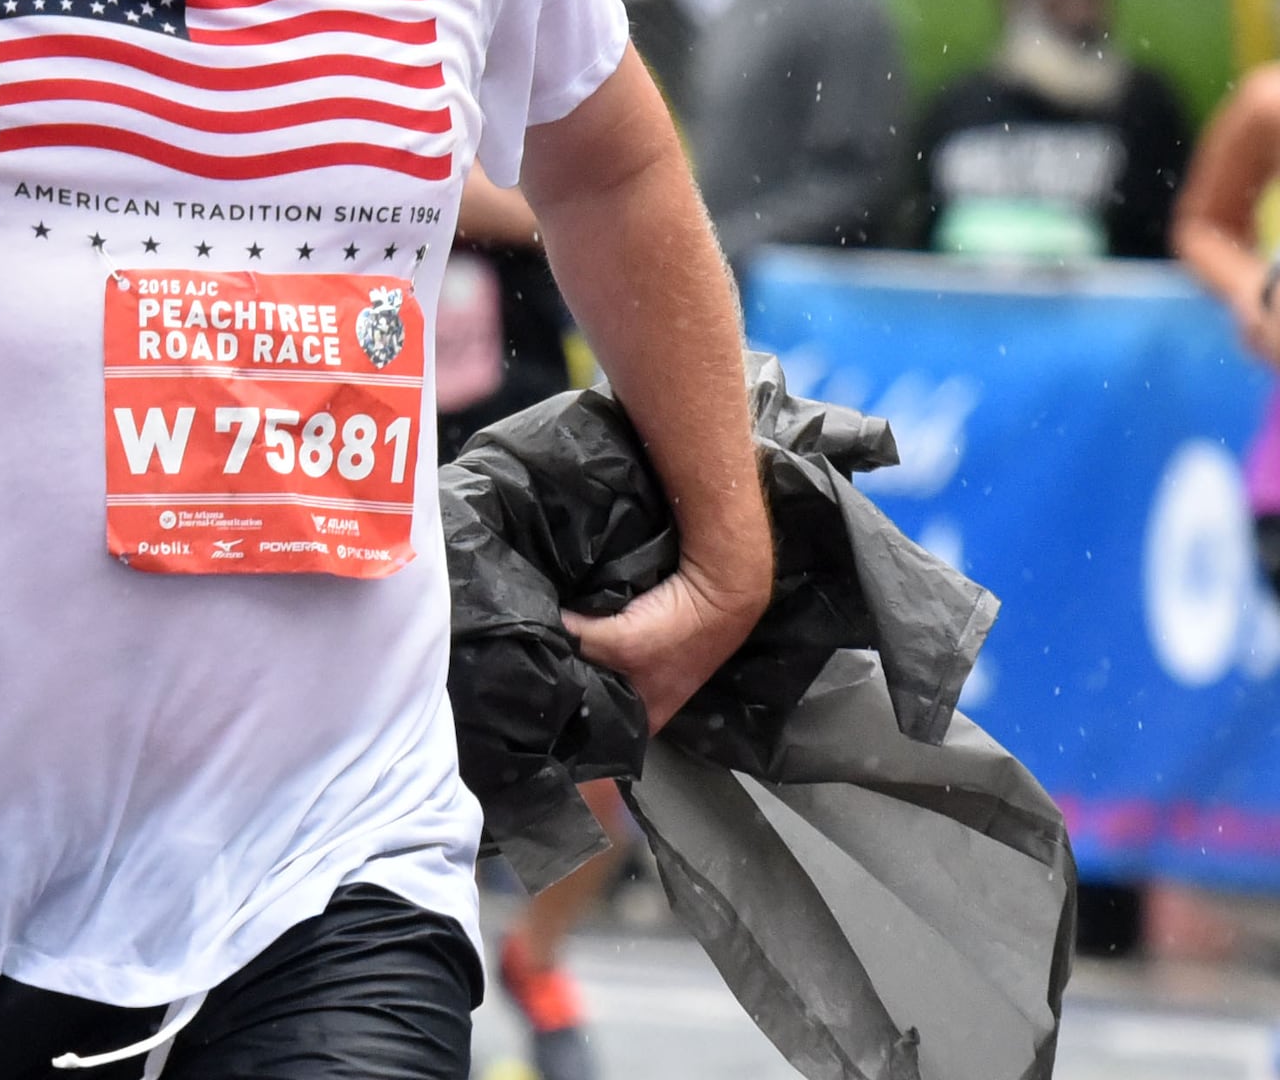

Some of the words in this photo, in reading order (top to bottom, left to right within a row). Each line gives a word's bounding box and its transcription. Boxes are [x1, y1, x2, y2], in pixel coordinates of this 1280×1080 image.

[14, 182, 160, 217] AMERICAN
[173, 202, 322, 222] TRADITION
[334, 206, 402, 224] SINCE
[409, 207, 441, 225] 1994
[138, 279, 181, 295] 2015
[185, 280, 218, 297] AJC
[138, 299, 338, 335] PEACHTREE
[139, 331, 238, 362] ROAD
[252, 333, 342, 366] RACE
[113, 407, 197, 474] W
[215, 407, 411, 483] 75881
[138, 541, 191, 555] Publix
